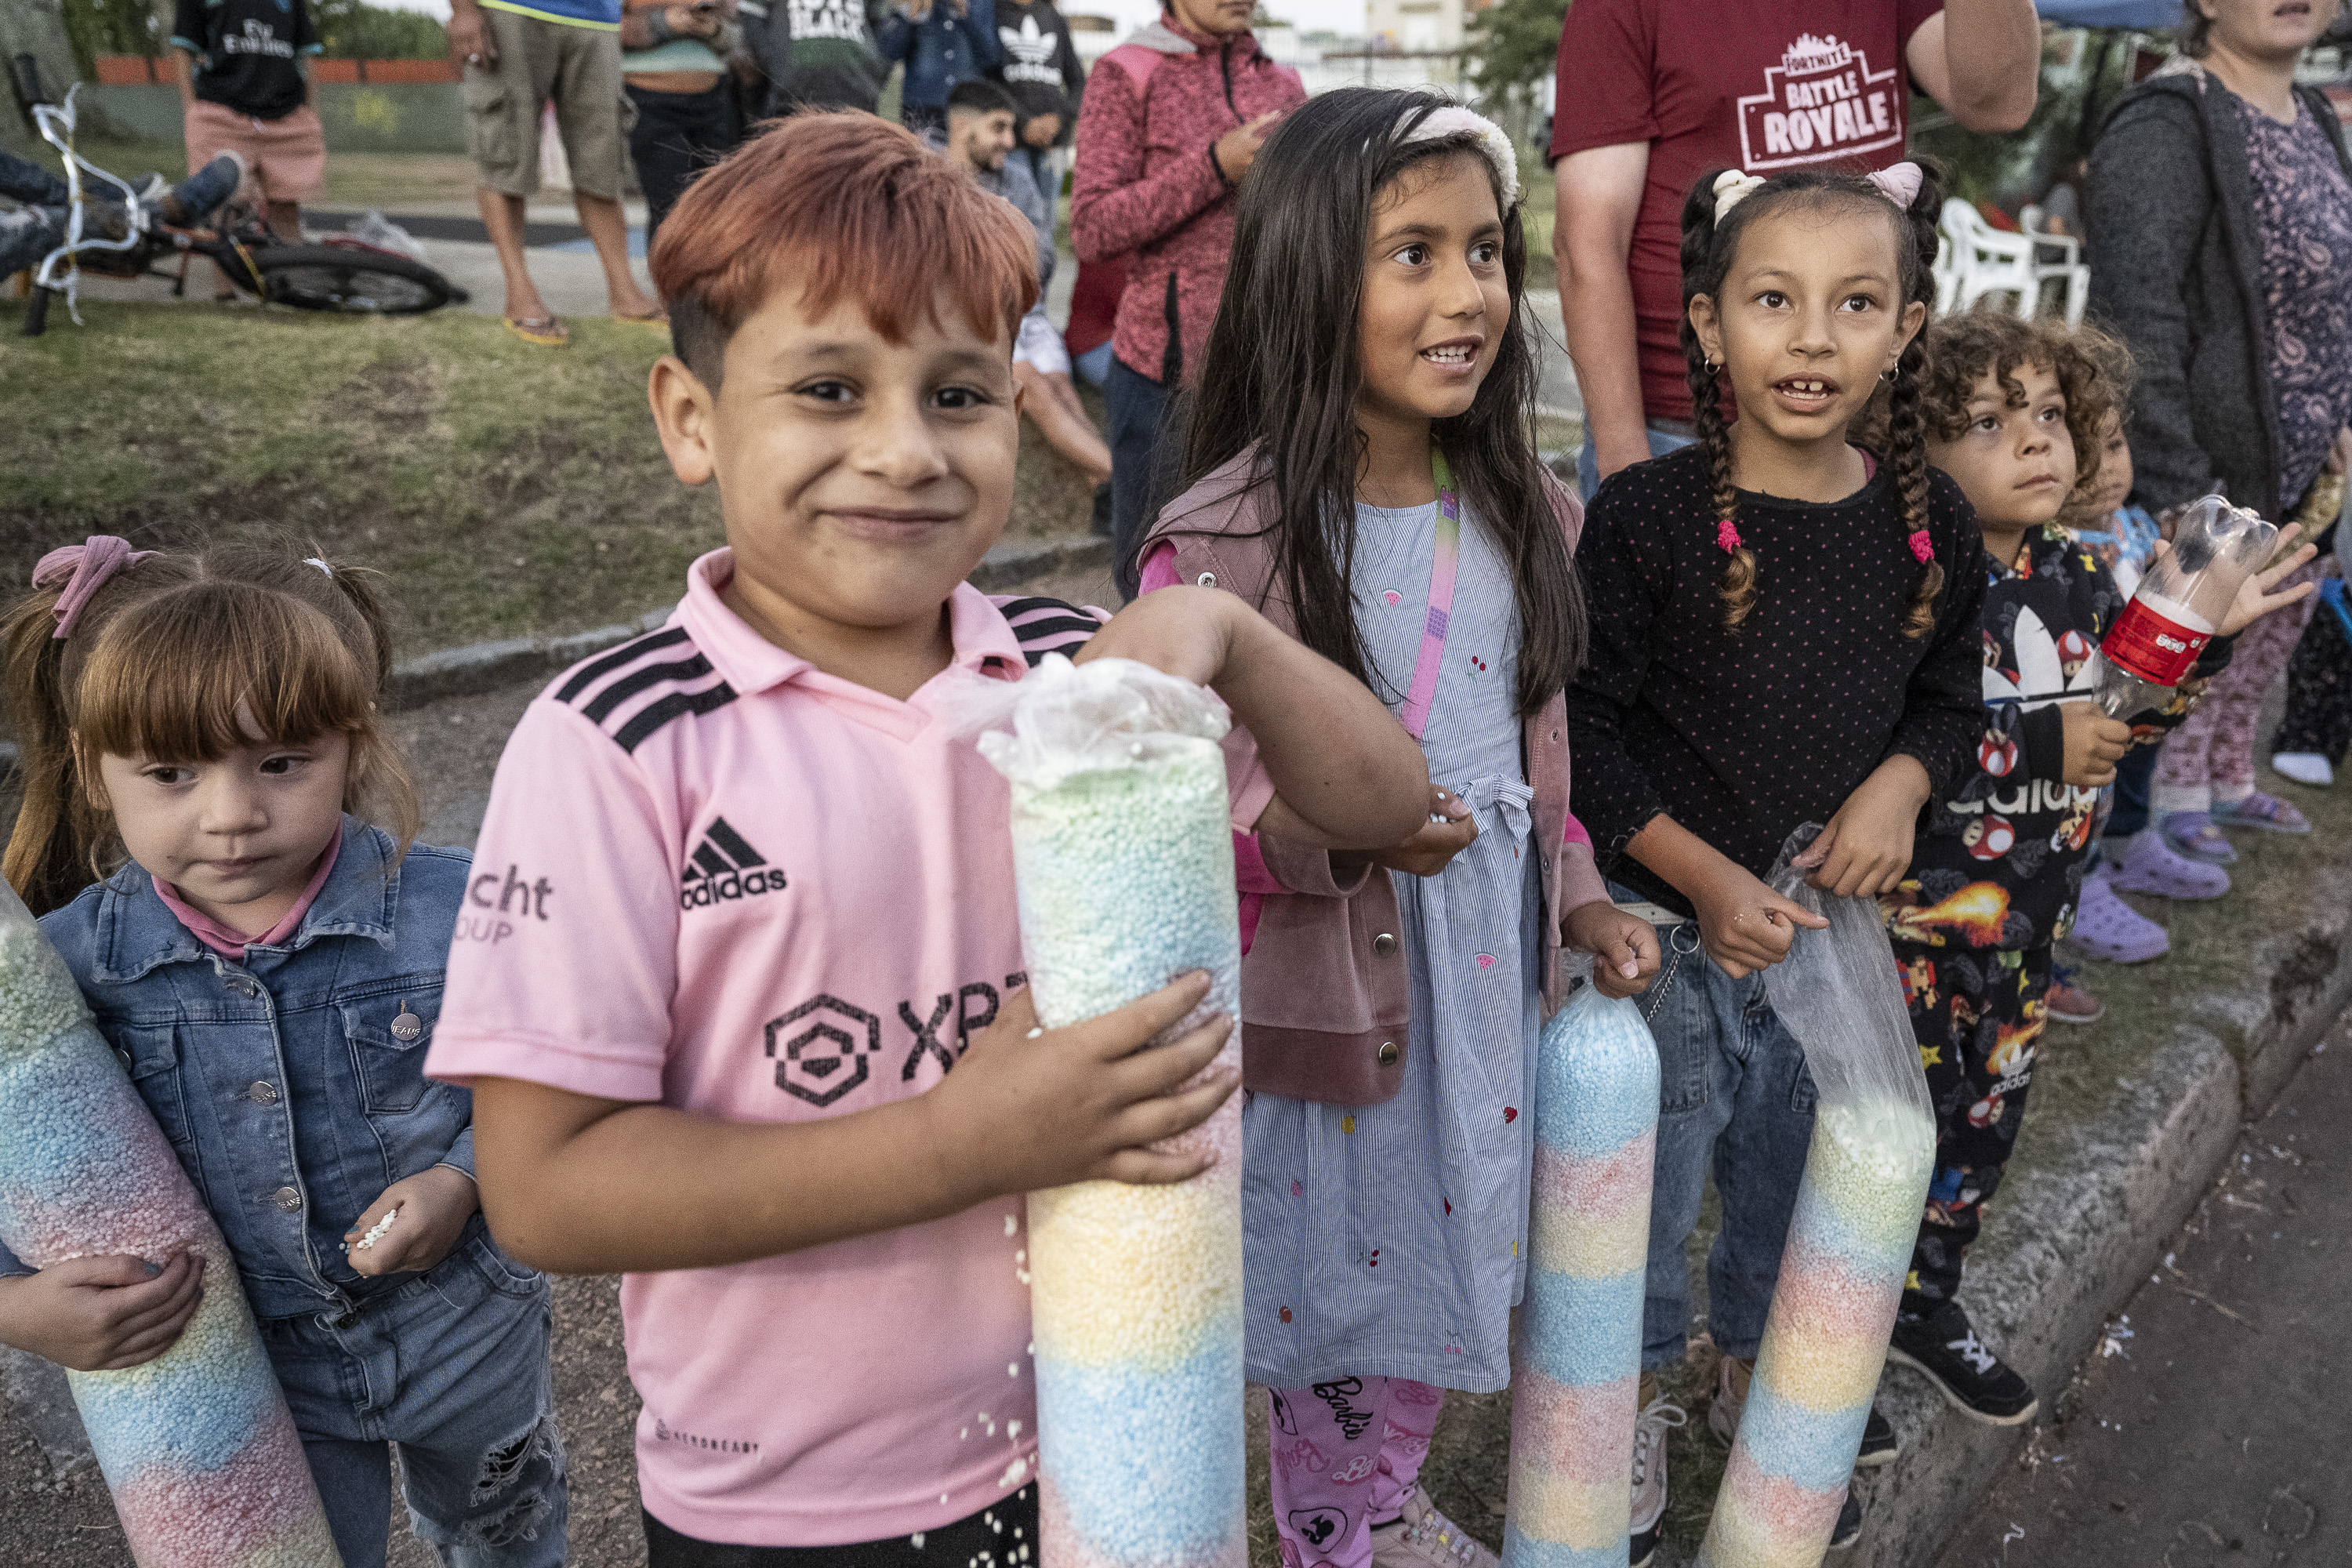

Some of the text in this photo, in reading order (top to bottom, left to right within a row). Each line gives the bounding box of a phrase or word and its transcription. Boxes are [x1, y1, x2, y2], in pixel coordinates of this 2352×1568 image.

[1785, 71, 1859, 109] BATTLE
[1764, 91, 1889, 154] ROYALE
[681, 869, 786, 910] adidas
[1990, 1072, 2031, 1097] adidas
[1312, 1376, 1374, 1440] Barbie
